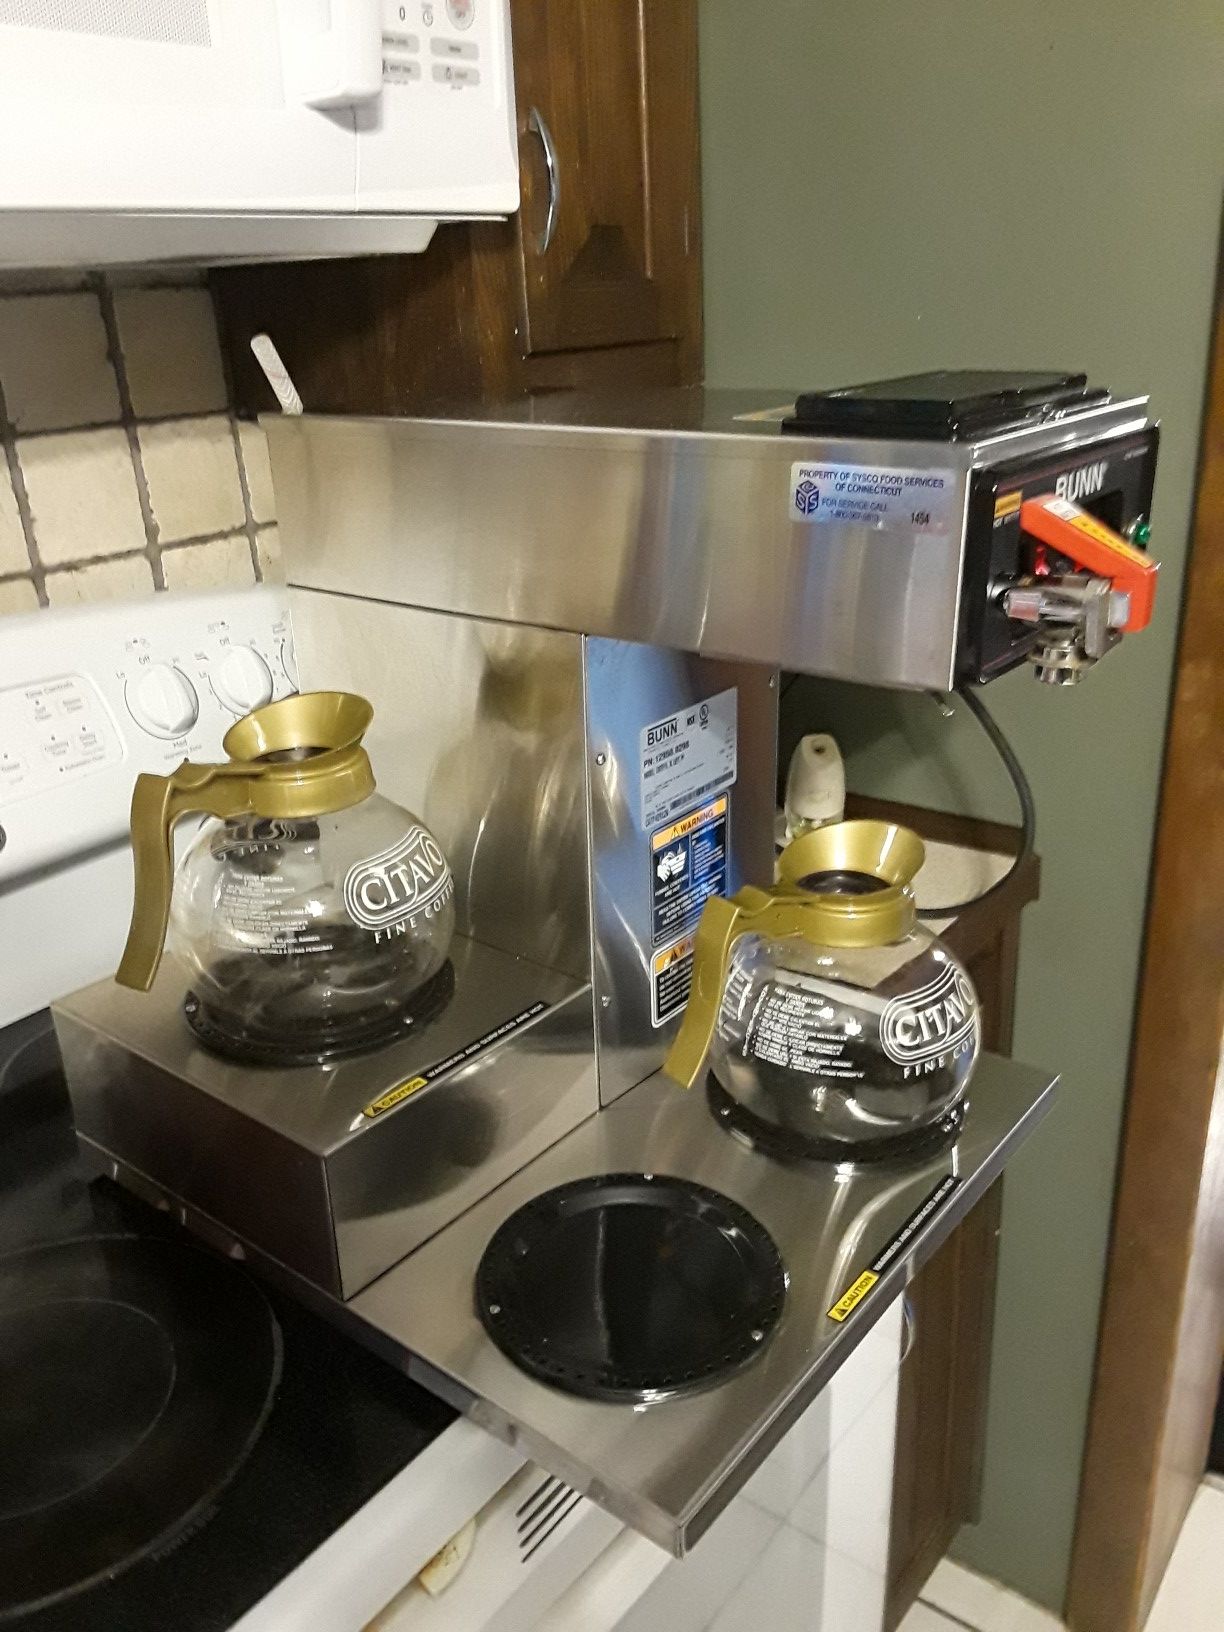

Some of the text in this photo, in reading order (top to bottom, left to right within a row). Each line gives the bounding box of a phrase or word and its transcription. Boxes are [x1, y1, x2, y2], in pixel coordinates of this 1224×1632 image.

[799, 469, 944, 489] PROPERTY OF SYSCO FOOD SERVICES
[835, 483, 902, 497] OF CONNECTICUT
[1055, 462, 1108, 502] BUNN
[647, 721, 678, 746] BUNN
[680, 808, 714, 833] WARNING
[360, 840, 443, 911] CITAVO
[375, 917, 417, 945] FINE
[895, 978, 974, 1047] CITAVO
[903, 1056, 945, 1079] FINE
[842, 1275, 873, 1308] CAUTION
